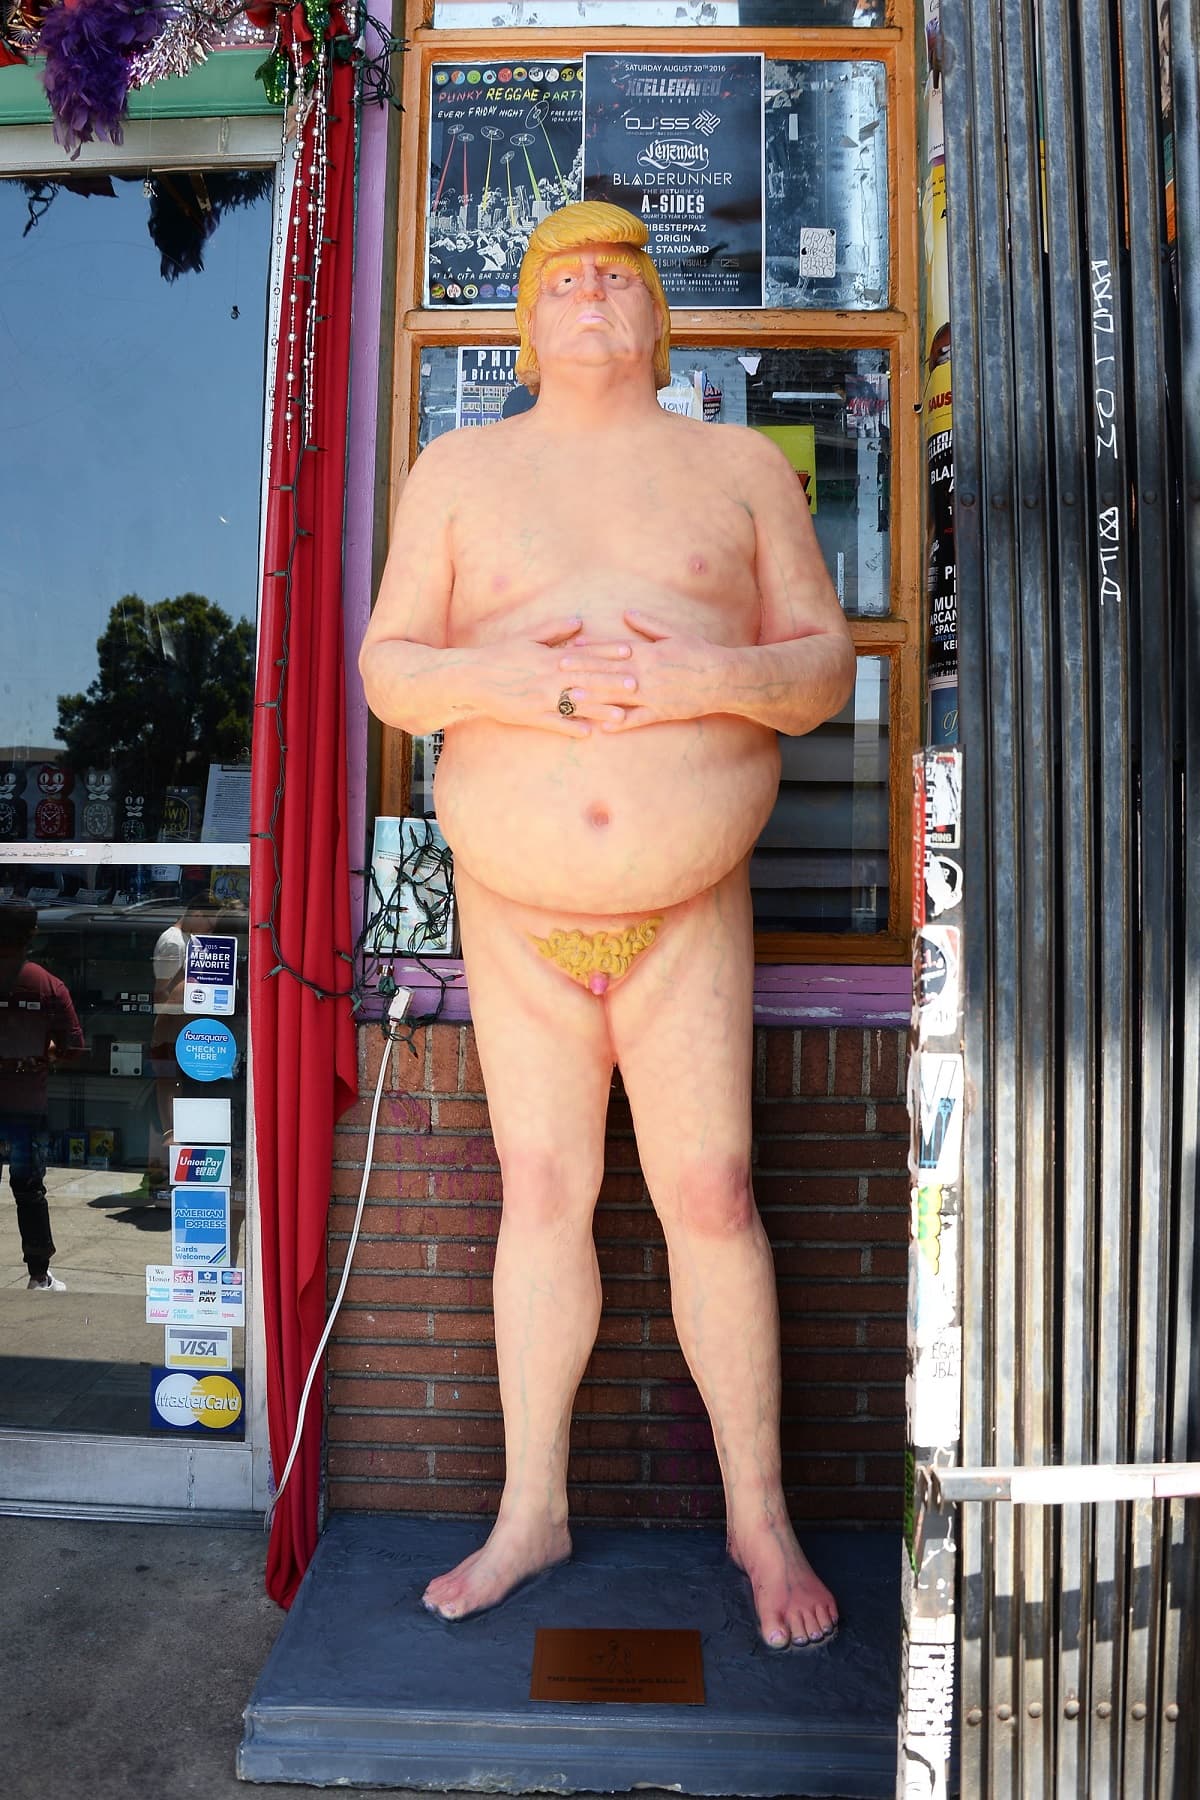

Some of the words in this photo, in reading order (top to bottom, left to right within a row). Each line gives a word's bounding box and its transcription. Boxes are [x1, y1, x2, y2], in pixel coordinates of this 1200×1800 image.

[625, 64, 662, 72] SATURDAY
[438, 90, 483, 103] PUNKY
[485, 87, 540, 101] REGGAE
[437, 110, 465, 119] EVERY
[468, 105, 498, 117] FRIDAY
[498, 109, 525, 118] NIGHT
[613, 172, 733, 185] BLADERUNNER
[641, 194, 705, 213] A-SIDES
[655, 234, 691, 243] ORIGIN
[656, 245, 710, 254] STANDARD
[457, 272, 475, 280] CITA
[190, 951, 231, 962] MEMBER
[190, 959, 230, 970] FAVORITE
[184, 1030, 229, 1043] foursquare
[186, 1045, 215, 1054] CHECK
[217, 1047, 227, 1055] IN
[194, 1053, 217, 1061] HERE
[179, 1156, 222, 1171] UnionPay
[175, 1208, 224, 1218] AMERICAN
[184, 1219, 227, 1230] EXPRESS
[175, 1245, 198, 1253] Cards
[175, 1252, 211, 1261] Welcome
[179, 1340, 217, 1356] VISA
[156, 1390, 239, 1411] MasterCard
